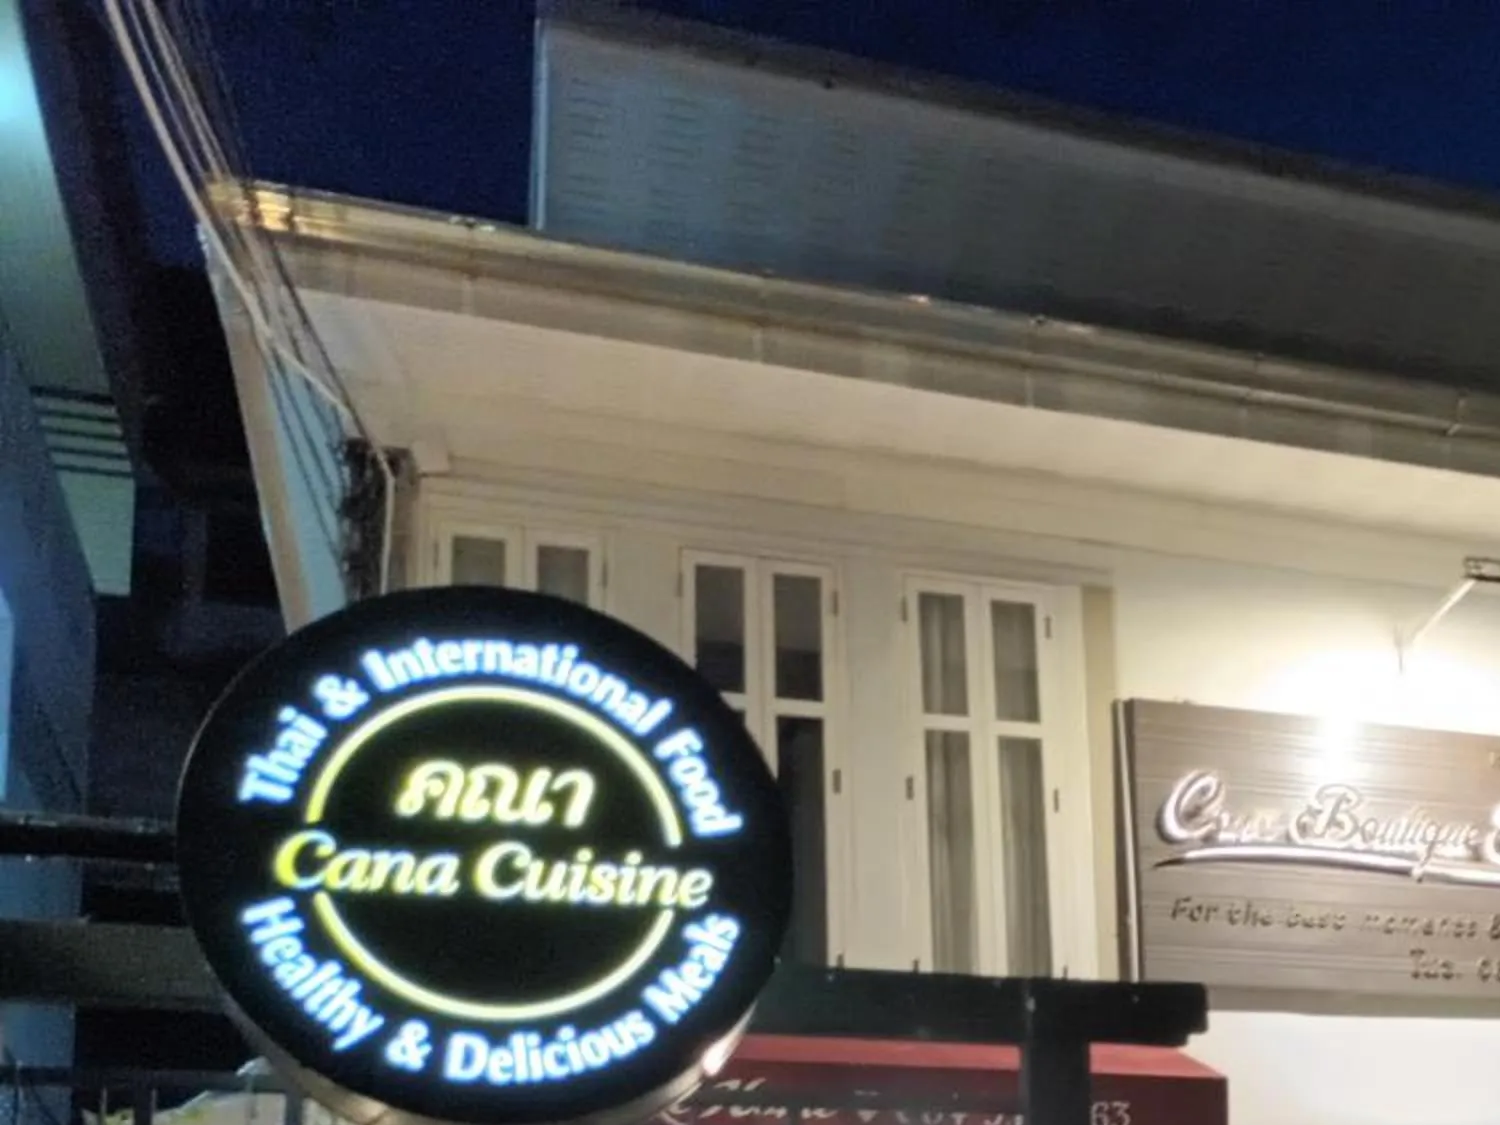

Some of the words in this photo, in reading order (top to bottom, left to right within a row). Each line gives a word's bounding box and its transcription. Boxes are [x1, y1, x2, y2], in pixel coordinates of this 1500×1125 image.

[238, 707, 328, 805] Thai
[313, 672, 369, 722] &
[361, 637, 674, 738] International
[655, 727, 743, 839] Food
[395, 759, 596, 828] คณา
[272, 829, 459, 894] Cana
[470, 839, 714, 909] Cuisine
[1171, 896, 1220, 924] For
[1227, 900, 1273, 927] the
[240, 895, 386, 1053] Healthy
[384, 1020, 433, 1072] &
[443, 1012, 656, 1086] Delicious
[641, 910, 743, 1026] Meals
